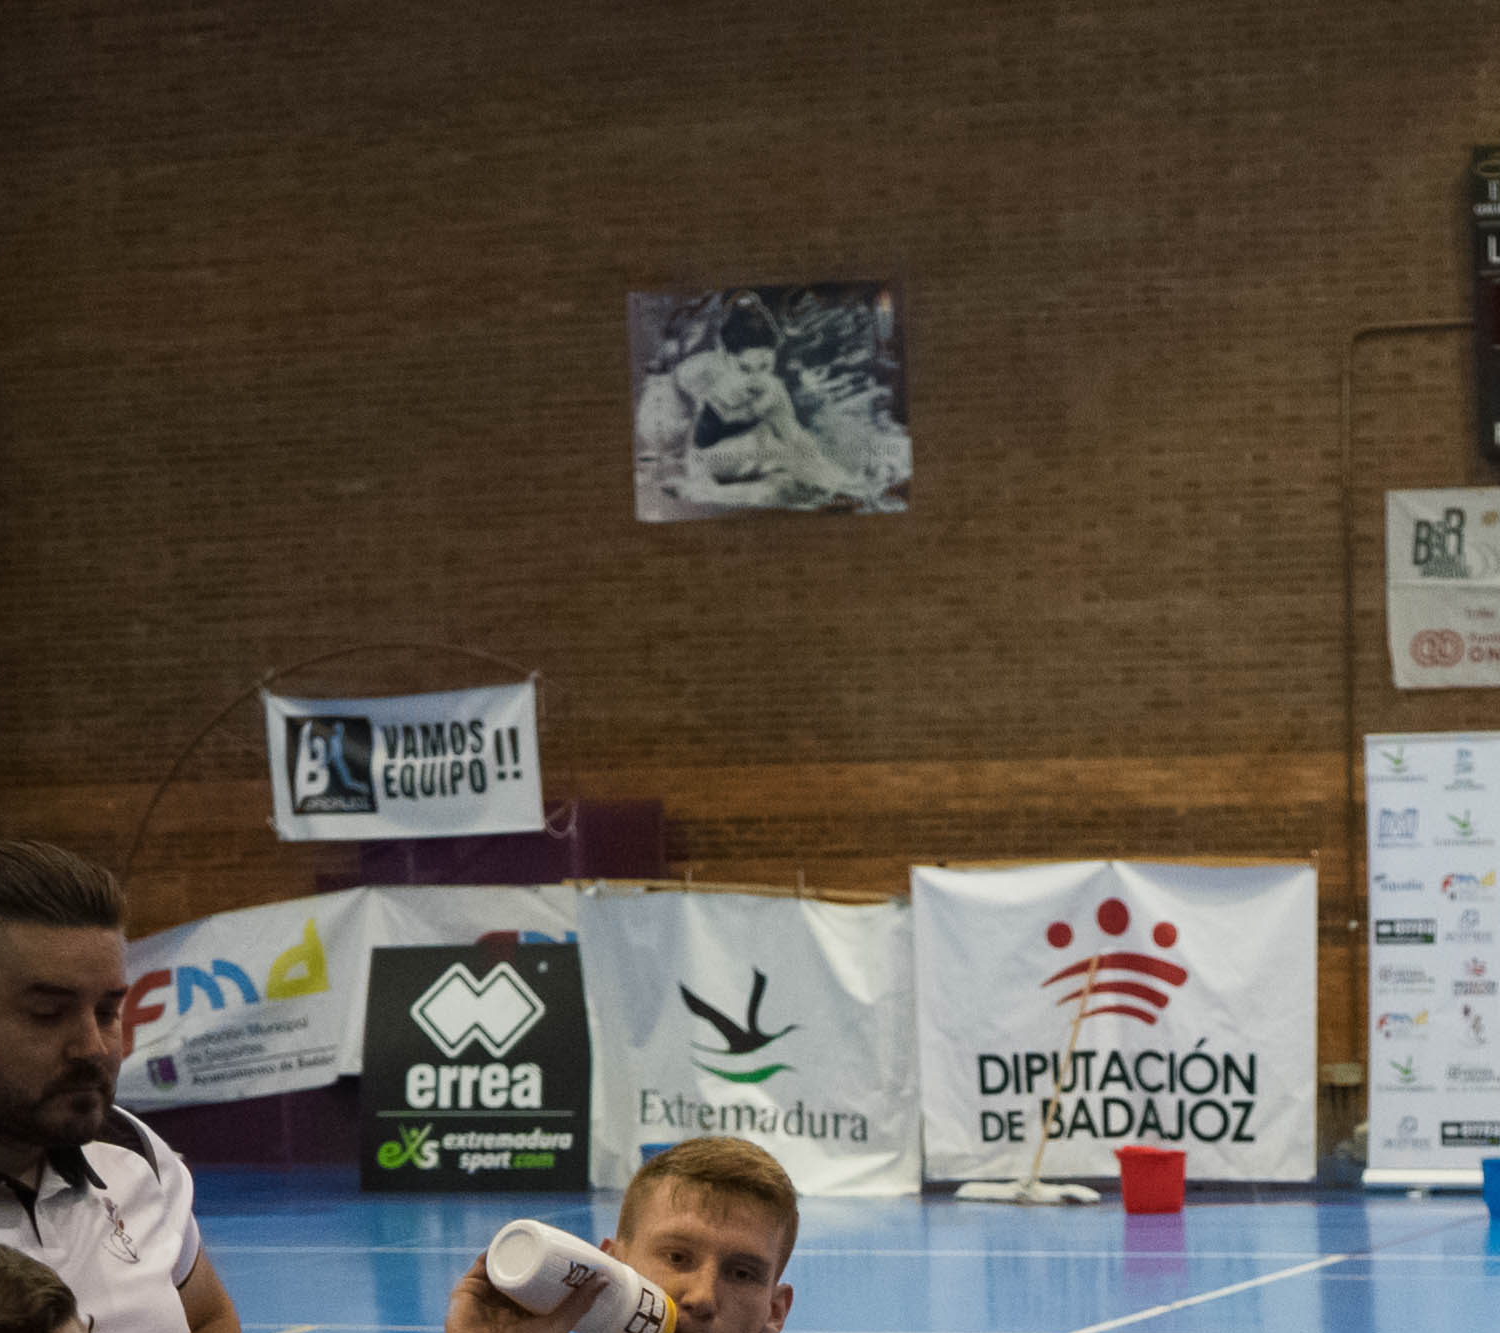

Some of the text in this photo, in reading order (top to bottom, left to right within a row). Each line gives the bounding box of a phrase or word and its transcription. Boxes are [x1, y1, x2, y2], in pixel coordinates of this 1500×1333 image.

[384, 720, 484, 759] VAMOS
[384, 758, 487, 798] EQUIPO
[407, 1063, 542, 1108] errea
[978, 1038, 1256, 1094] DIPUTACIÓN
[640, 1089, 868, 1142] Extremadura
[981, 1098, 1255, 1142] DE BADAJOZ
[443, 1128, 573, 1151] extremadura
